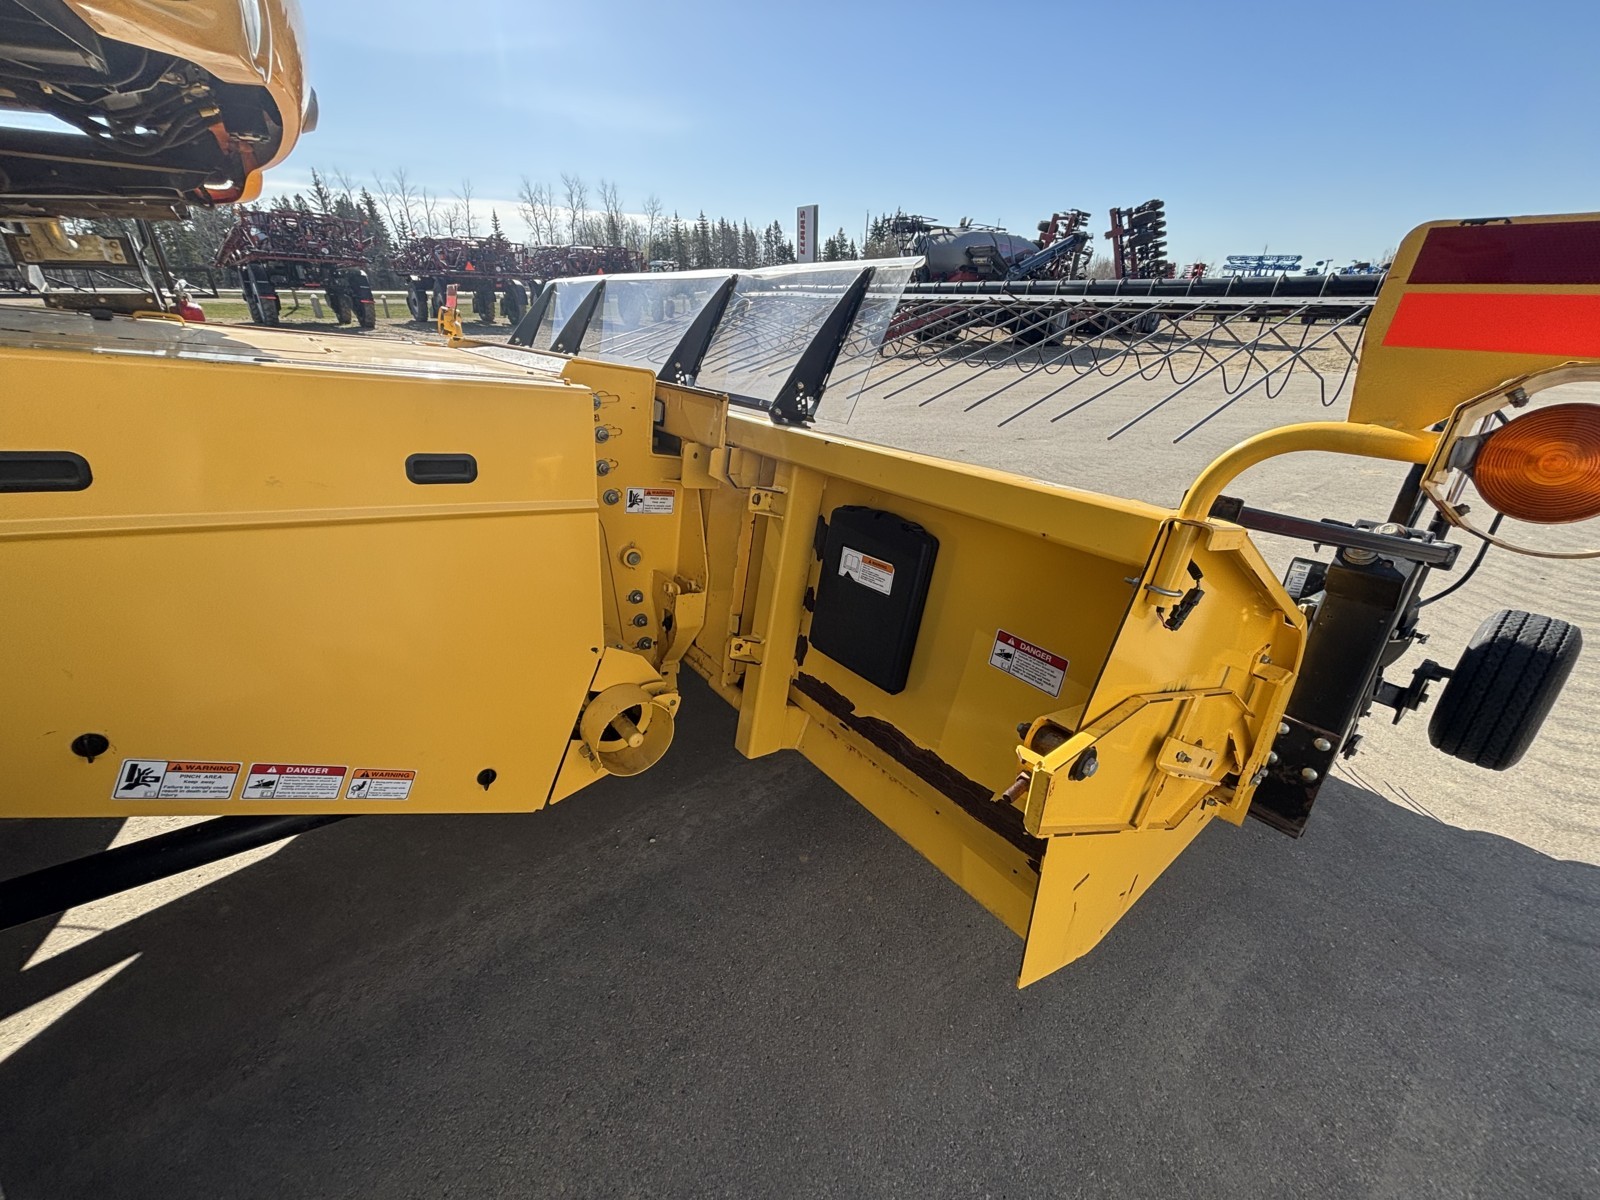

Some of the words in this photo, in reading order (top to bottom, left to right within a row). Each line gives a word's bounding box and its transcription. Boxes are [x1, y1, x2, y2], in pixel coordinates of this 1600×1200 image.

[1020, 643, 1052, 662] DANGER
[186, 764, 234, 772] WARNING
[286, 766, 329, 774] DANGER
